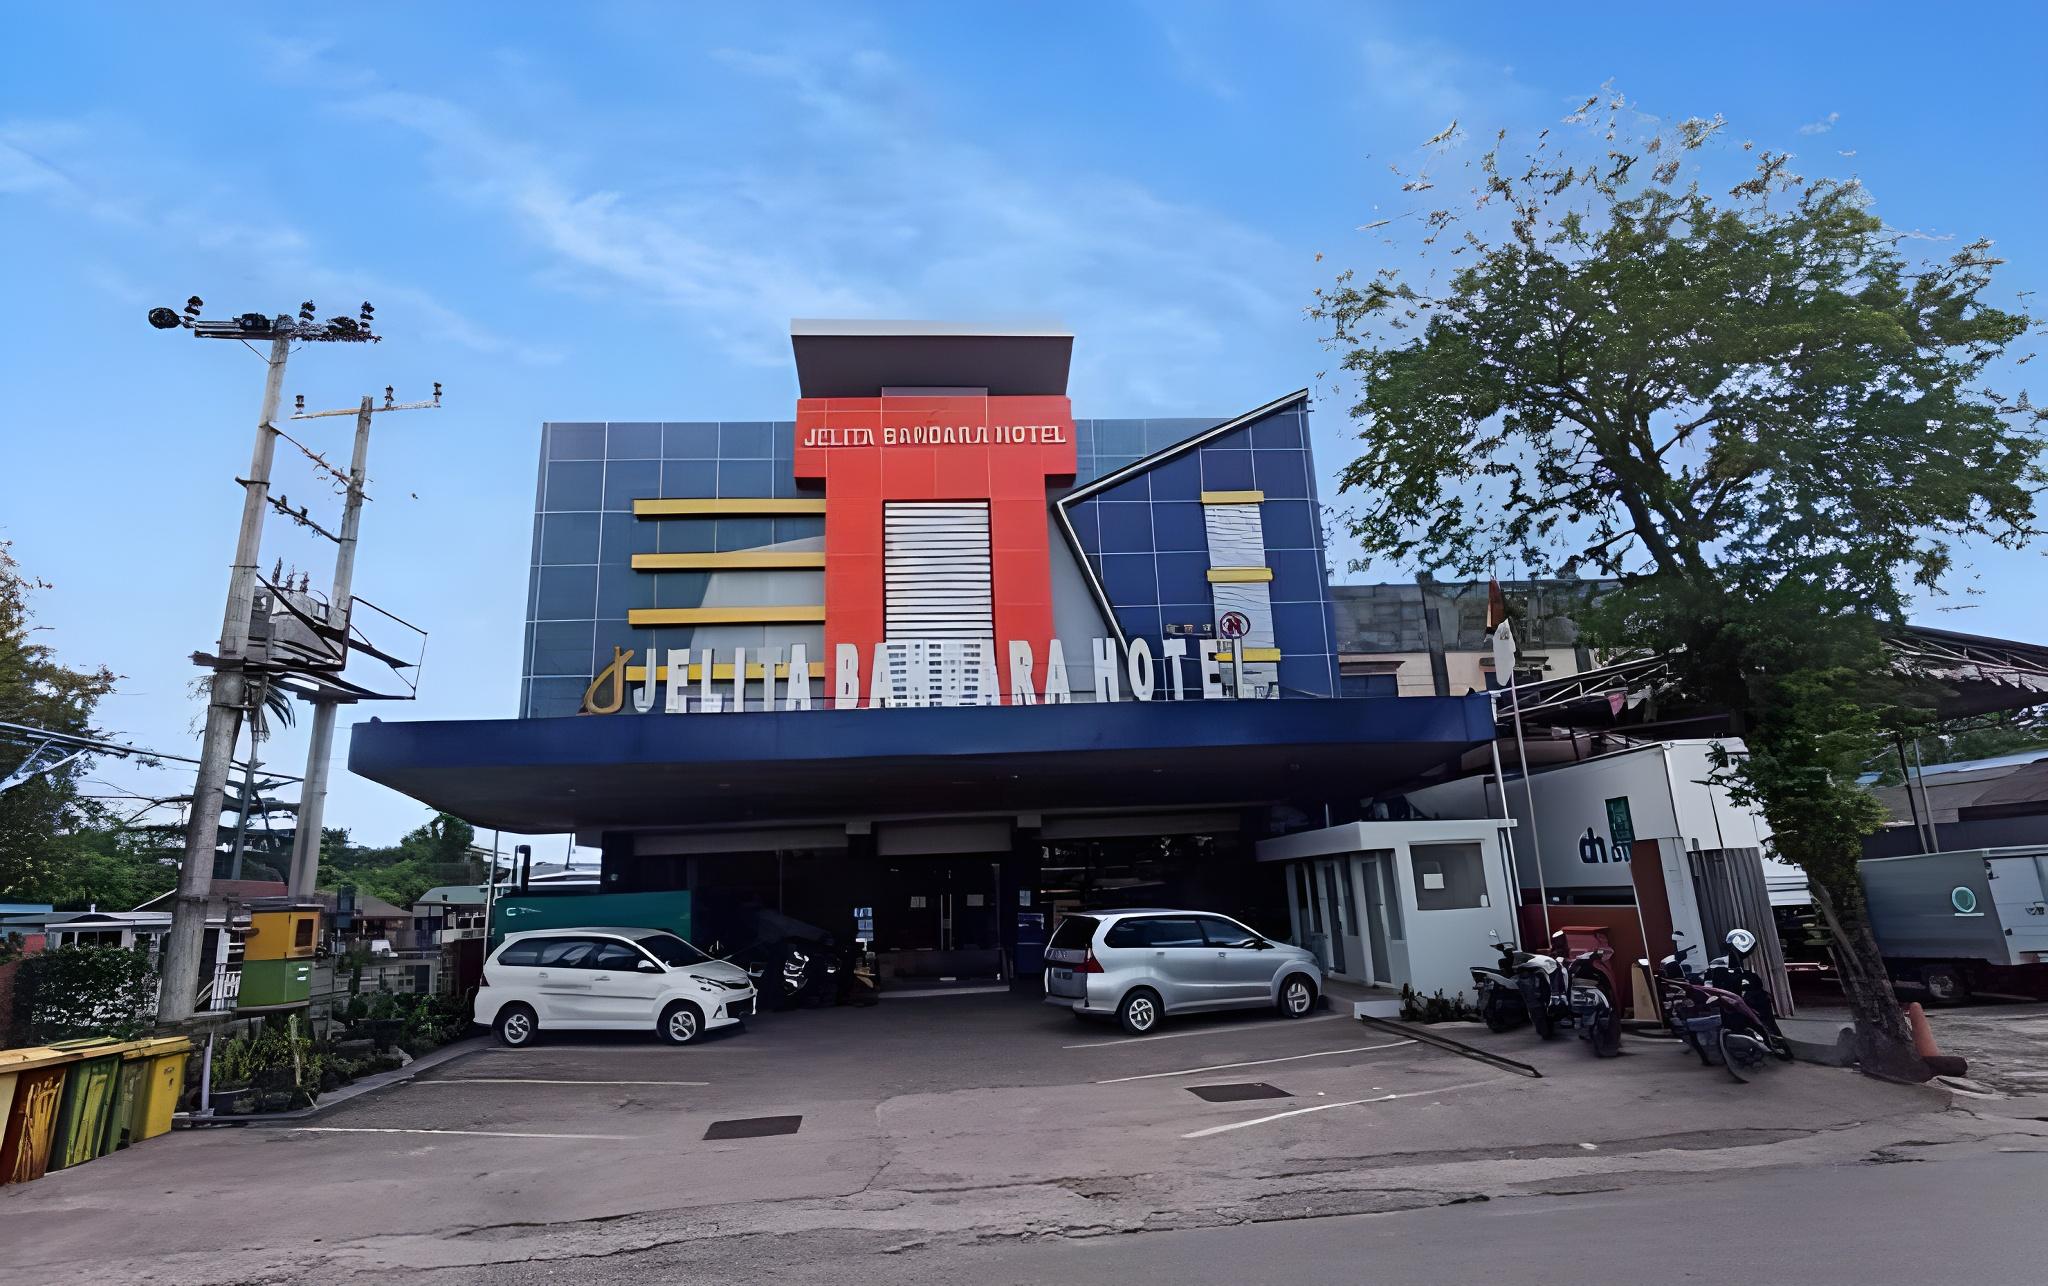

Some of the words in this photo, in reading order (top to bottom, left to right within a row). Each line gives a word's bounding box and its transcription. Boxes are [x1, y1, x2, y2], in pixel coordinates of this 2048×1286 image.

[633, 643, 812, 713] JELITA
[835, 639, 1071, 709] BAARA
[1093, 637, 1280, 703] HOTEL
